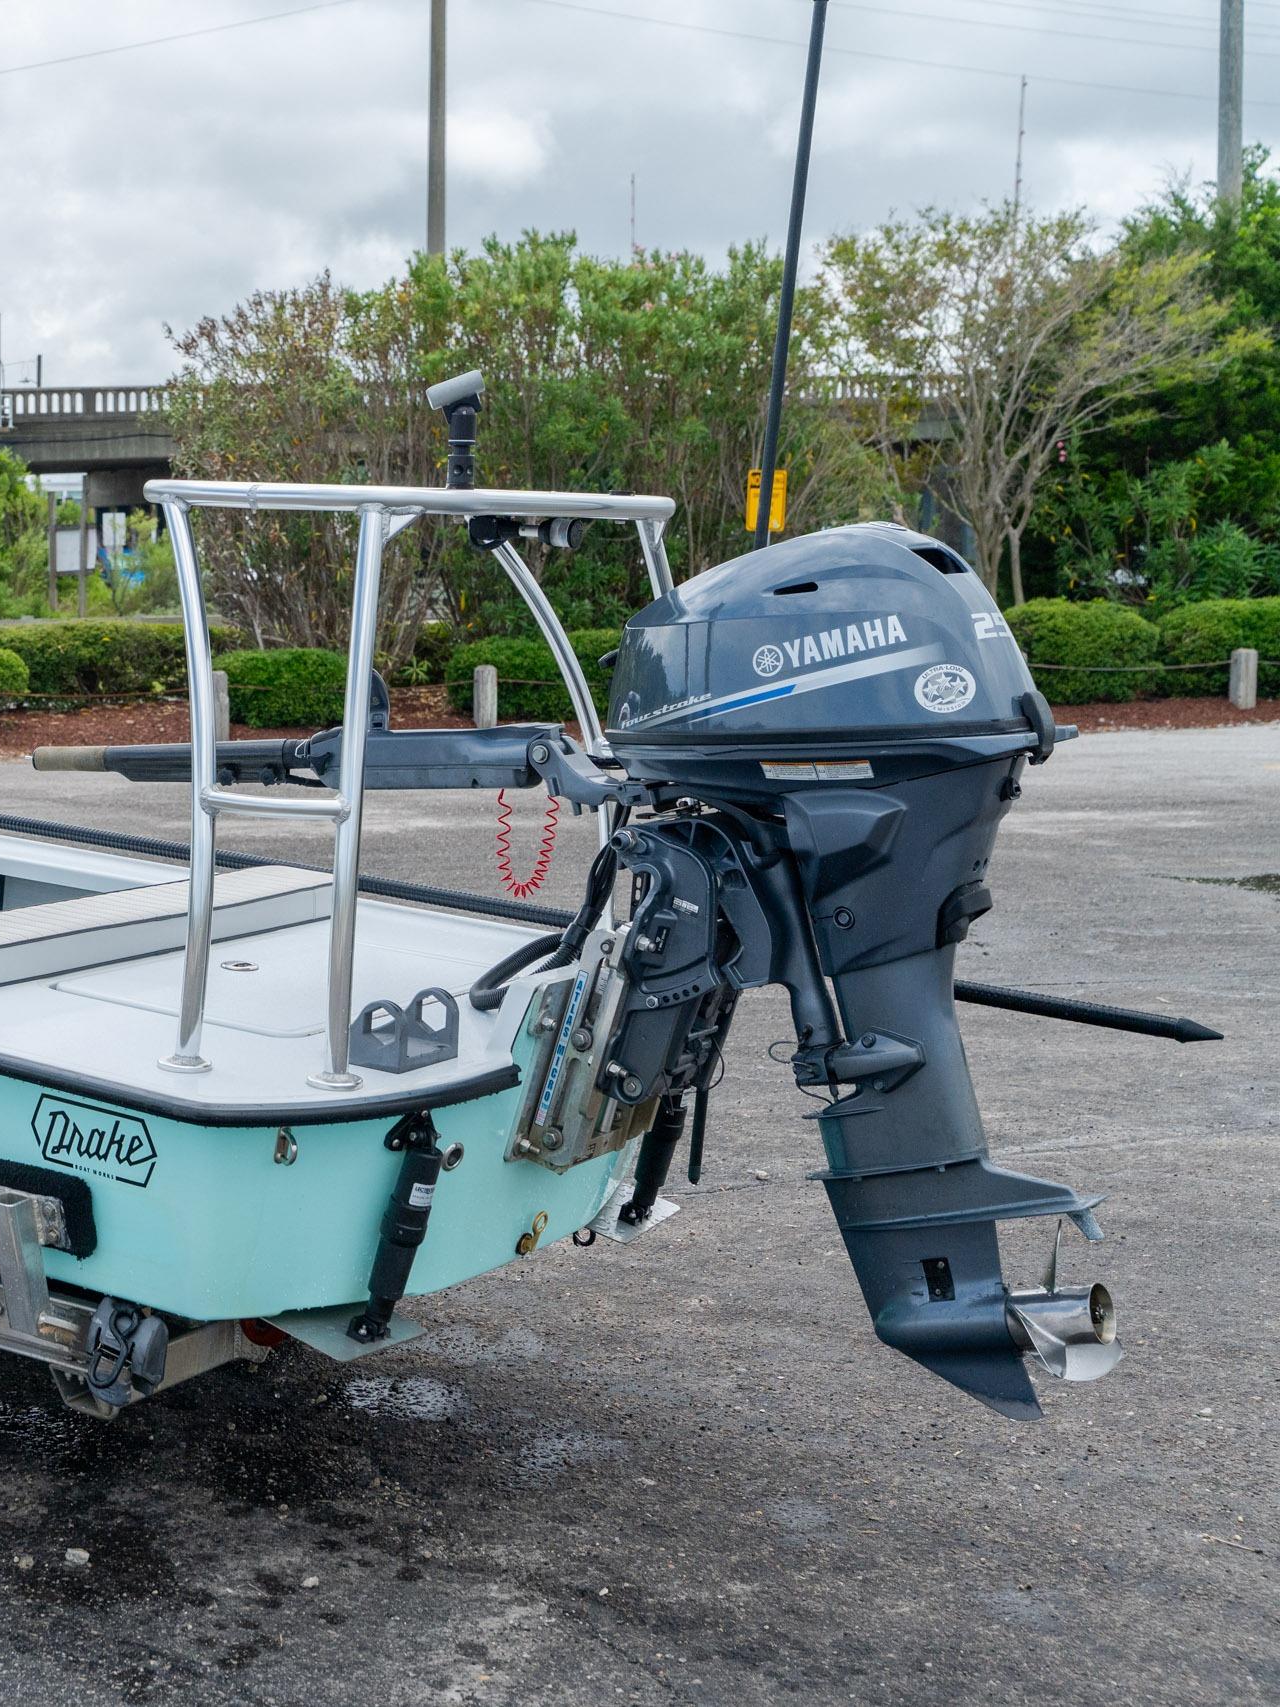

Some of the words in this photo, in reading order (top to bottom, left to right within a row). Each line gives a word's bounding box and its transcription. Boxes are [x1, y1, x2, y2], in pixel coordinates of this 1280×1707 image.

[783, 615, 907, 668] YAMAHA
[563, 980, 584, 1038] ATLAS
[544, 1044, 566, 1102] MICRO
[42, 1110, 150, 1167] Drake
[75, 1164, 90, 1173] BOAT
[93, 1169, 114, 1180] WORKS
